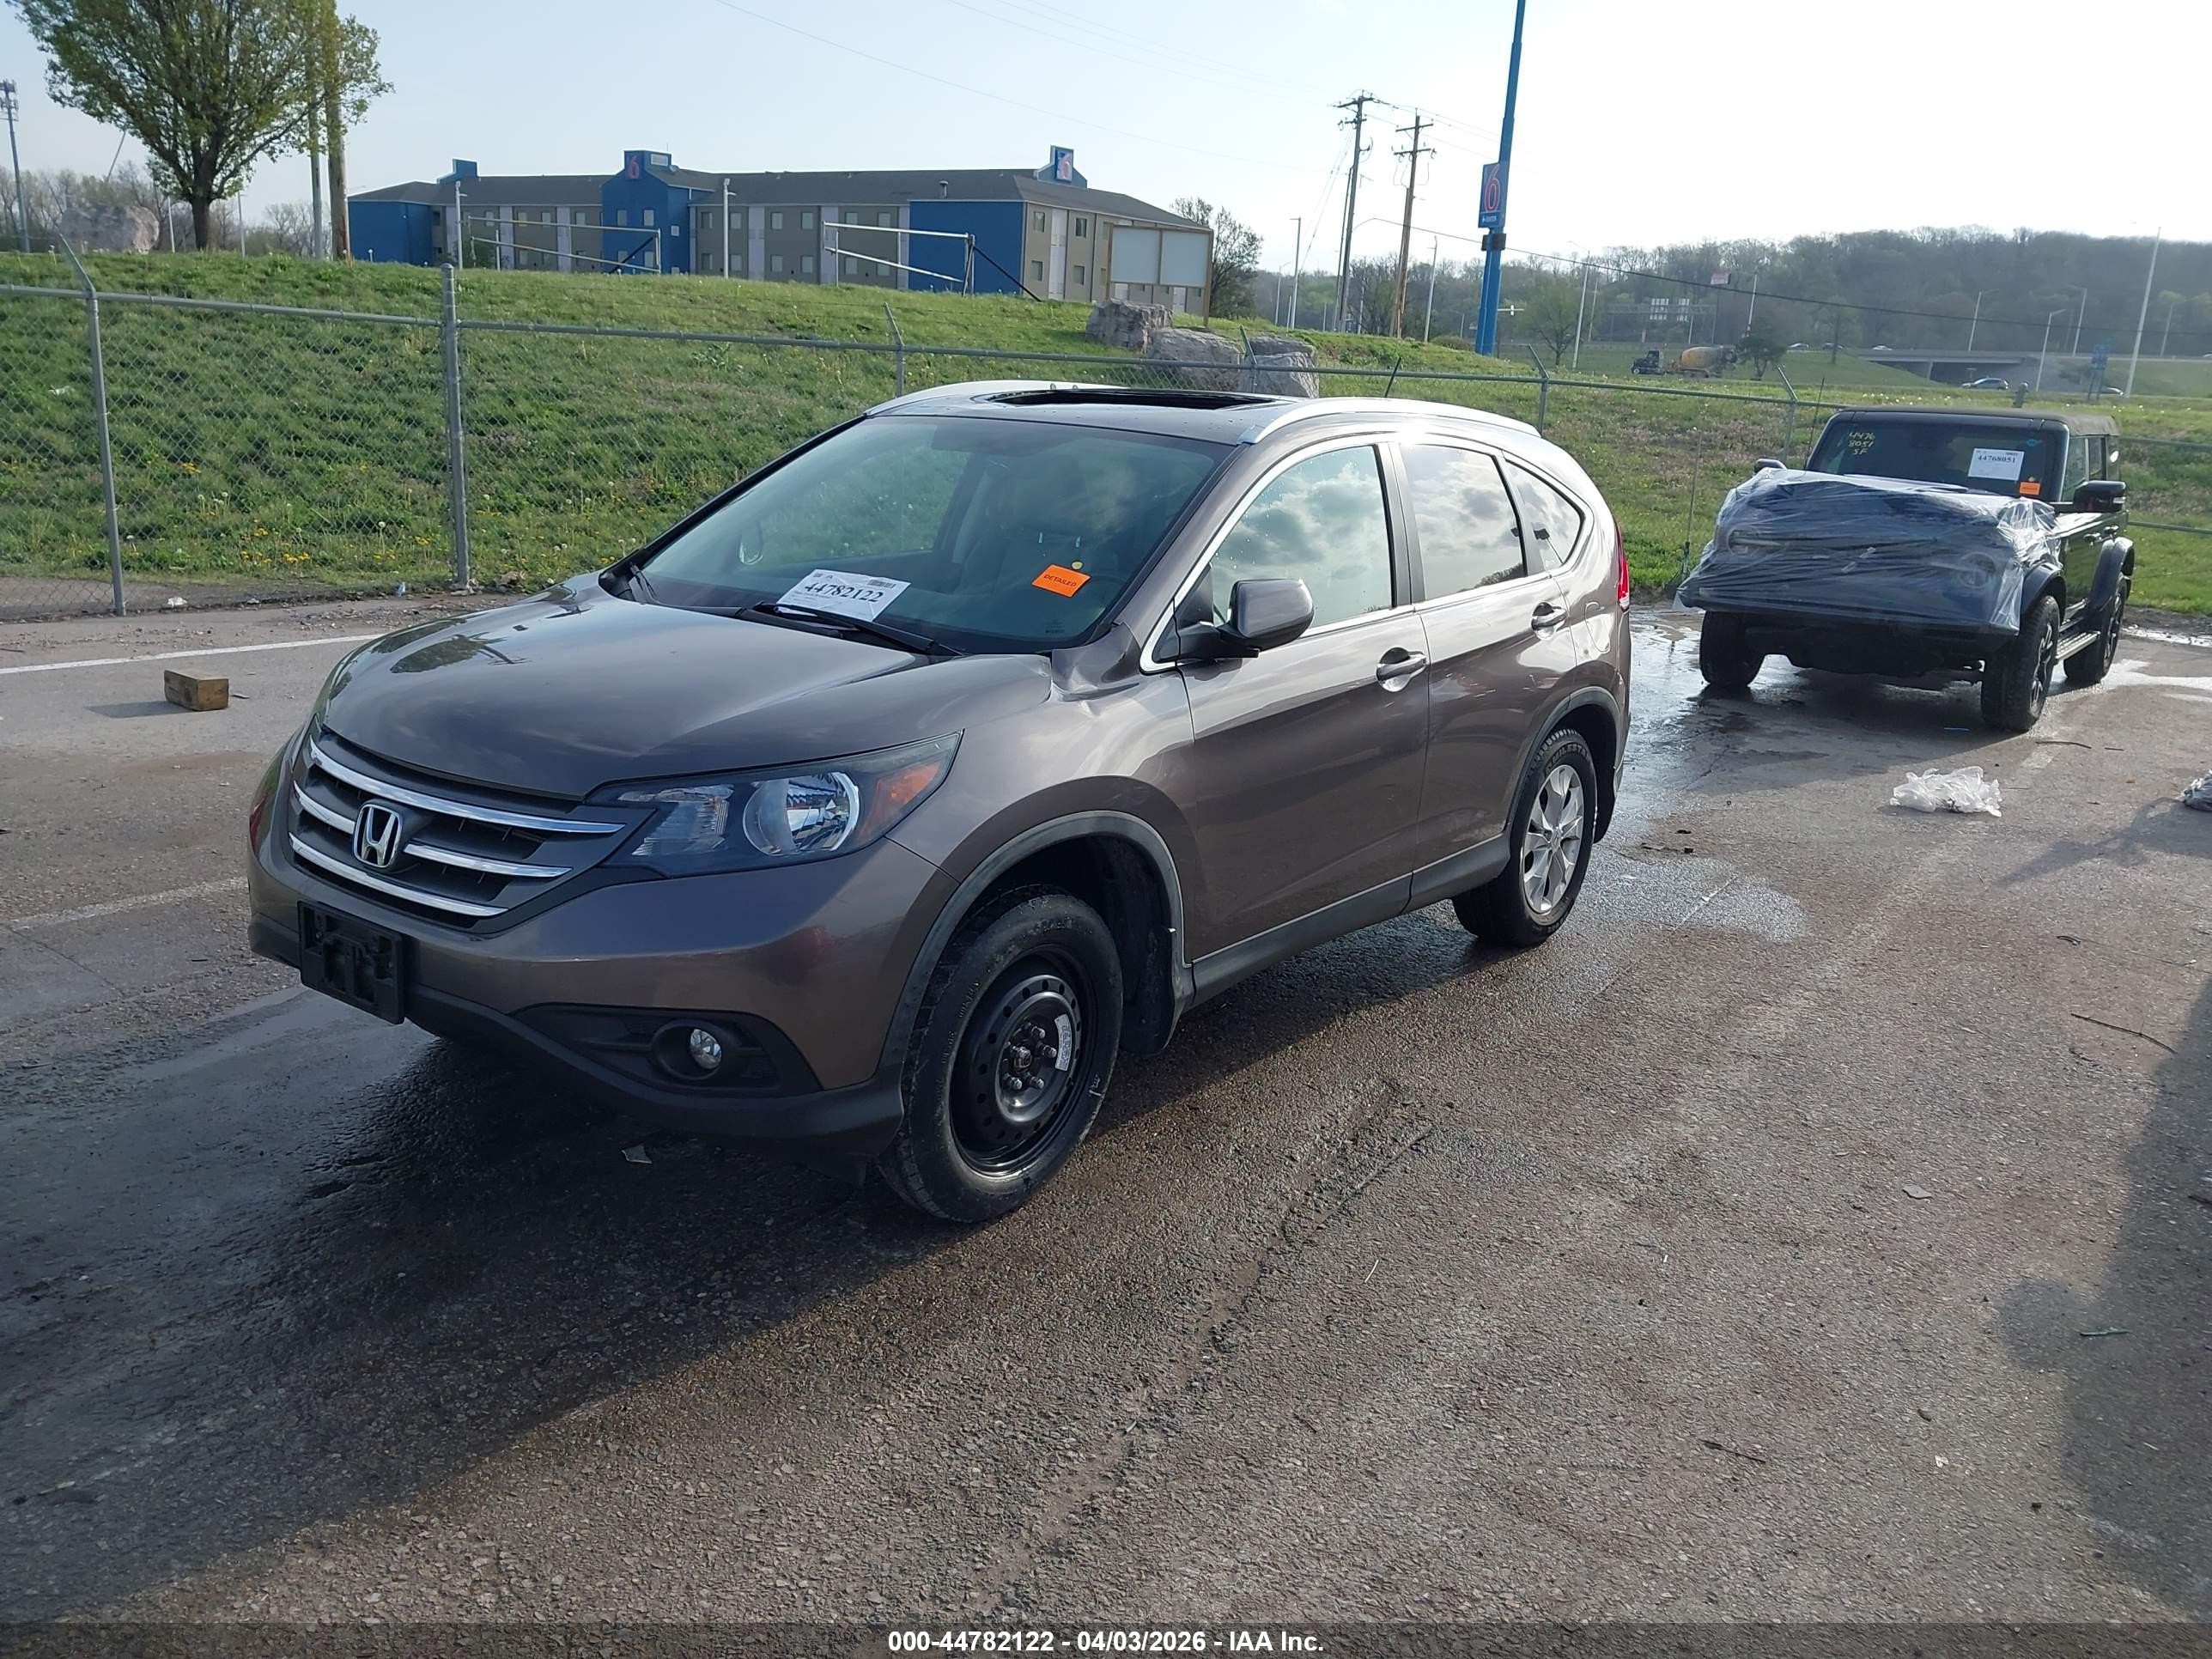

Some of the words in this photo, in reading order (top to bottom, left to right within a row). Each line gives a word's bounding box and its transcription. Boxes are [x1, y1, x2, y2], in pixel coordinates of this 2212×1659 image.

[1484, 163, 1500, 213] 6
[1043, 574, 1077, 587] DETAILED
[804, 582, 884, 603] 44782122
